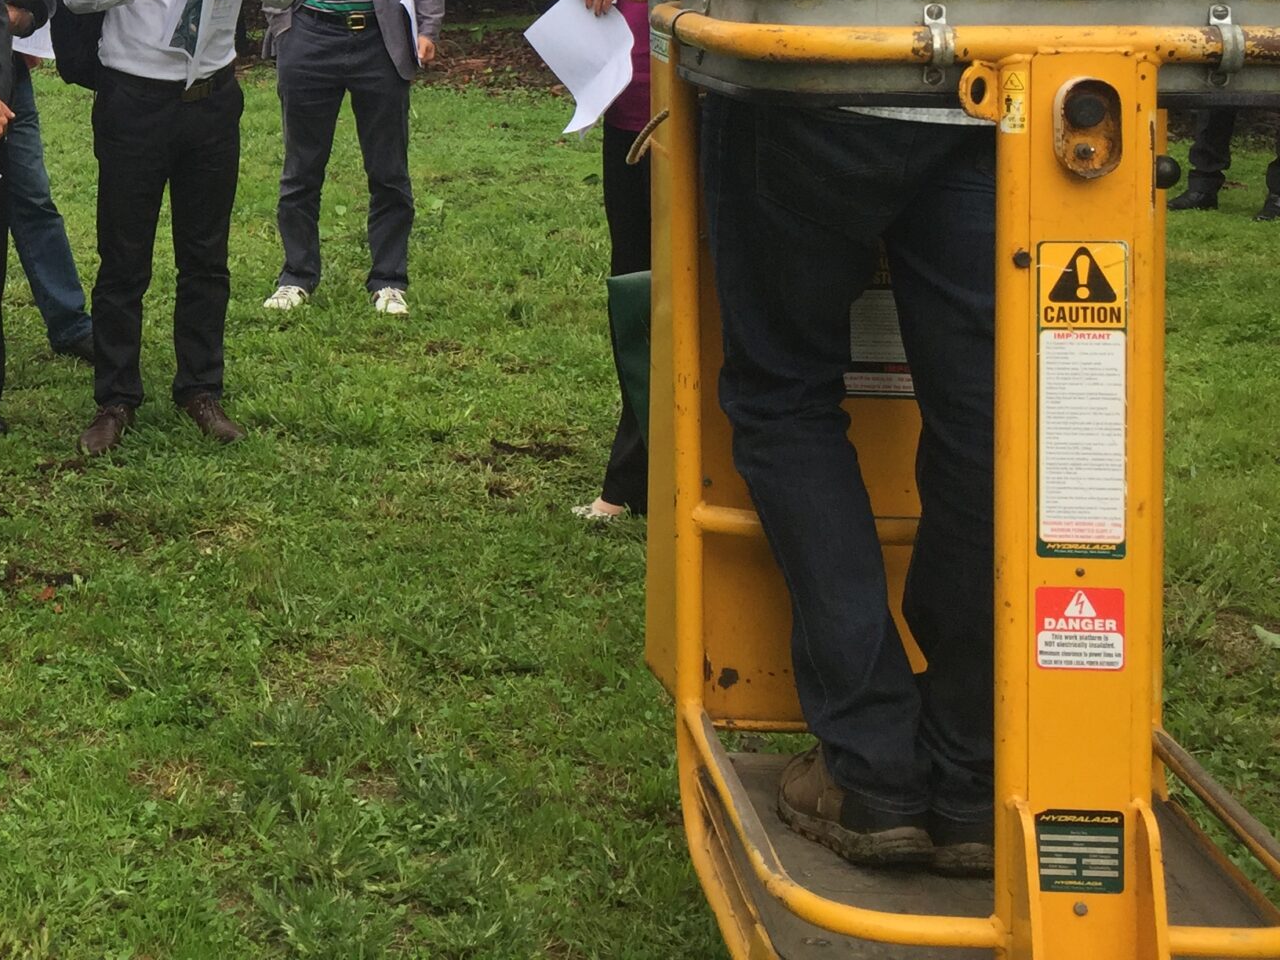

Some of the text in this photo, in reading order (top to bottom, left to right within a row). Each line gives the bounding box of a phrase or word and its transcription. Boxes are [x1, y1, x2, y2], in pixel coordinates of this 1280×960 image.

[1044, 306, 1121, 323] CAUTION
[1044, 617, 1117, 631] DANGER
[1040, 815, 1119, 823] HYDRALADA
